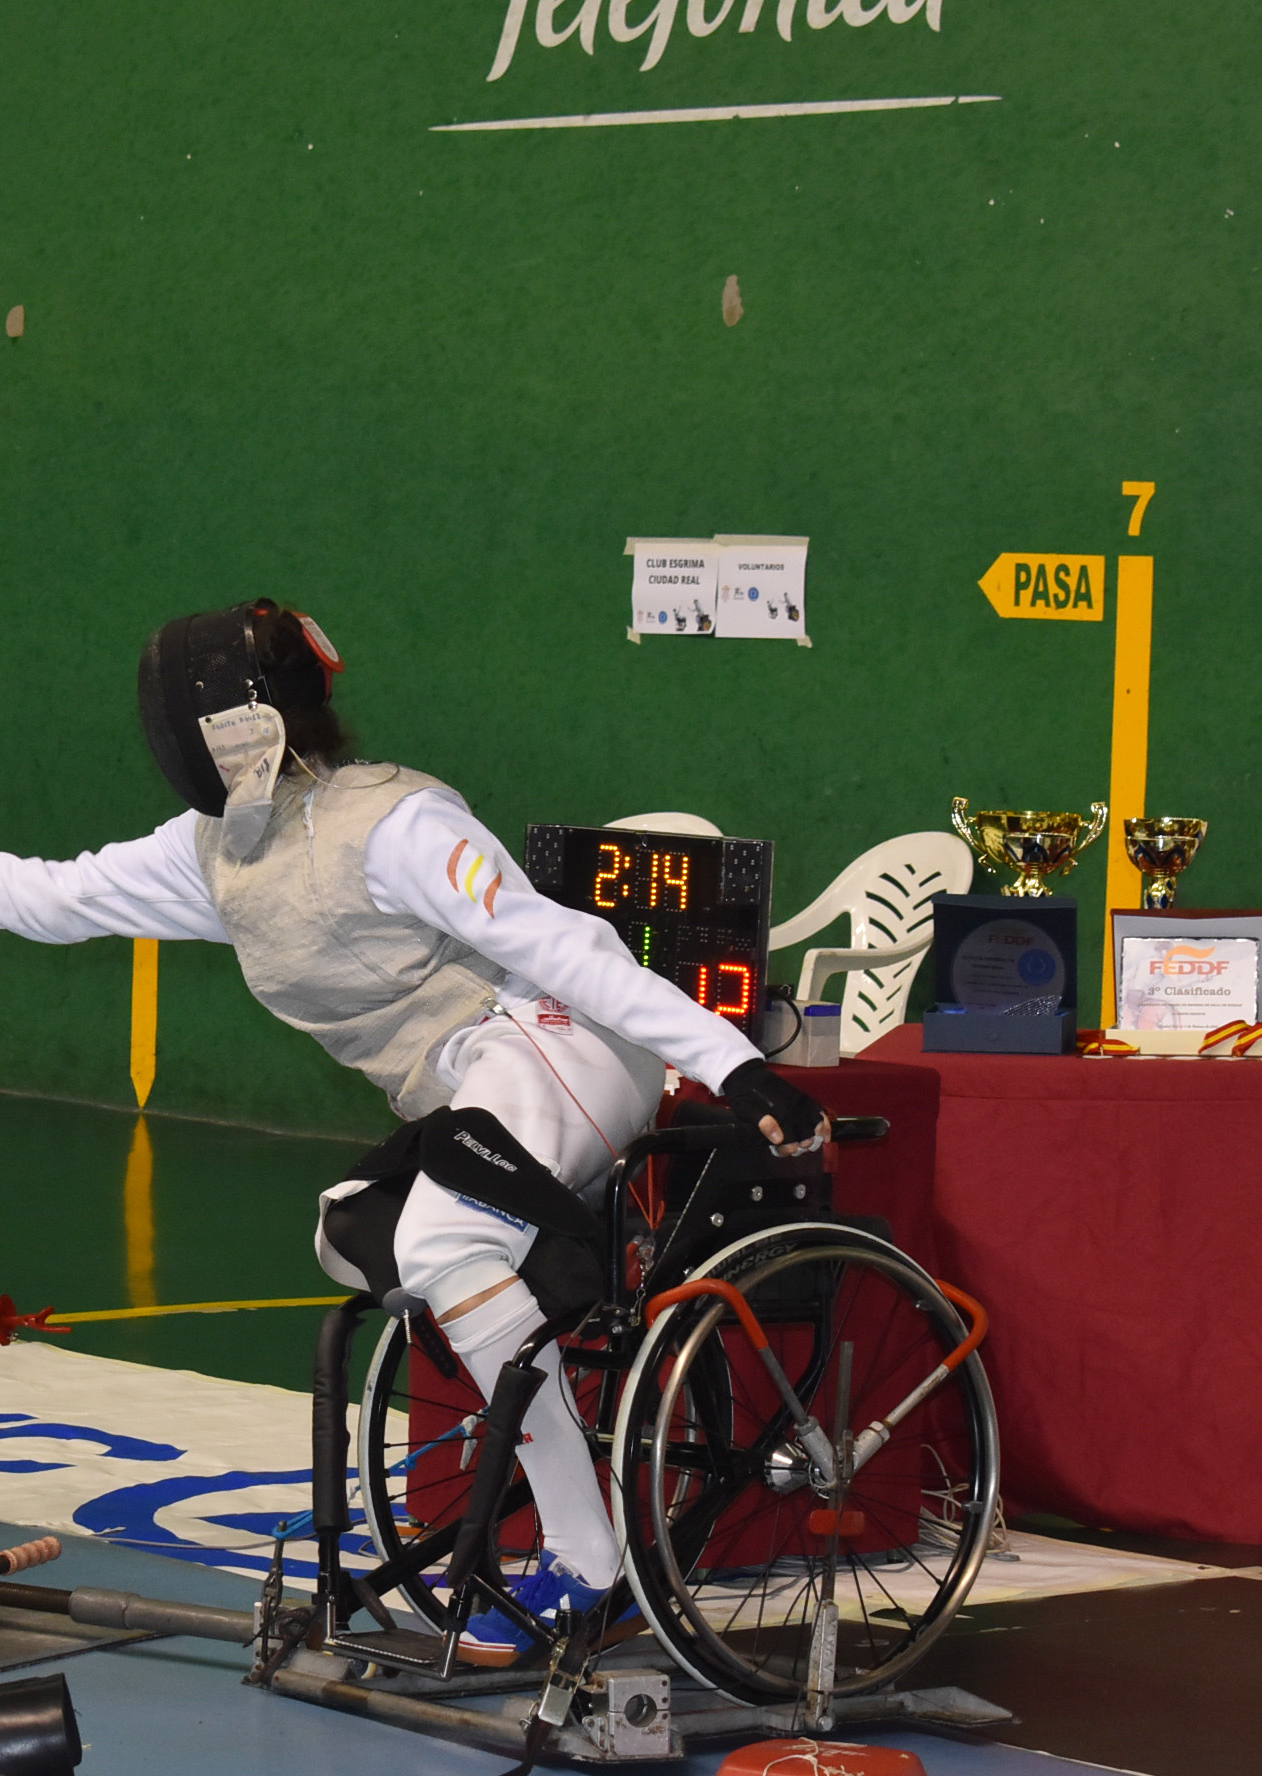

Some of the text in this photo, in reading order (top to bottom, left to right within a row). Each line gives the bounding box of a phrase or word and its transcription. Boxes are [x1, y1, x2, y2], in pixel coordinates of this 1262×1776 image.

[1122, 481, 1156, 536] 7
[646, 558, 705, 569] CLUB ESGRIMA
[738, 563, 784, 571] VOLUNTARIOS
[648, 575, 700, 585] CIUDAD REAL
[1013, 562, 1094, 610] PASA
[594, 843, 689, 910] 2:14
[1149, 957, 1230, 976] FEDDF
[1164, 986, 1231, 996] Clasificado
